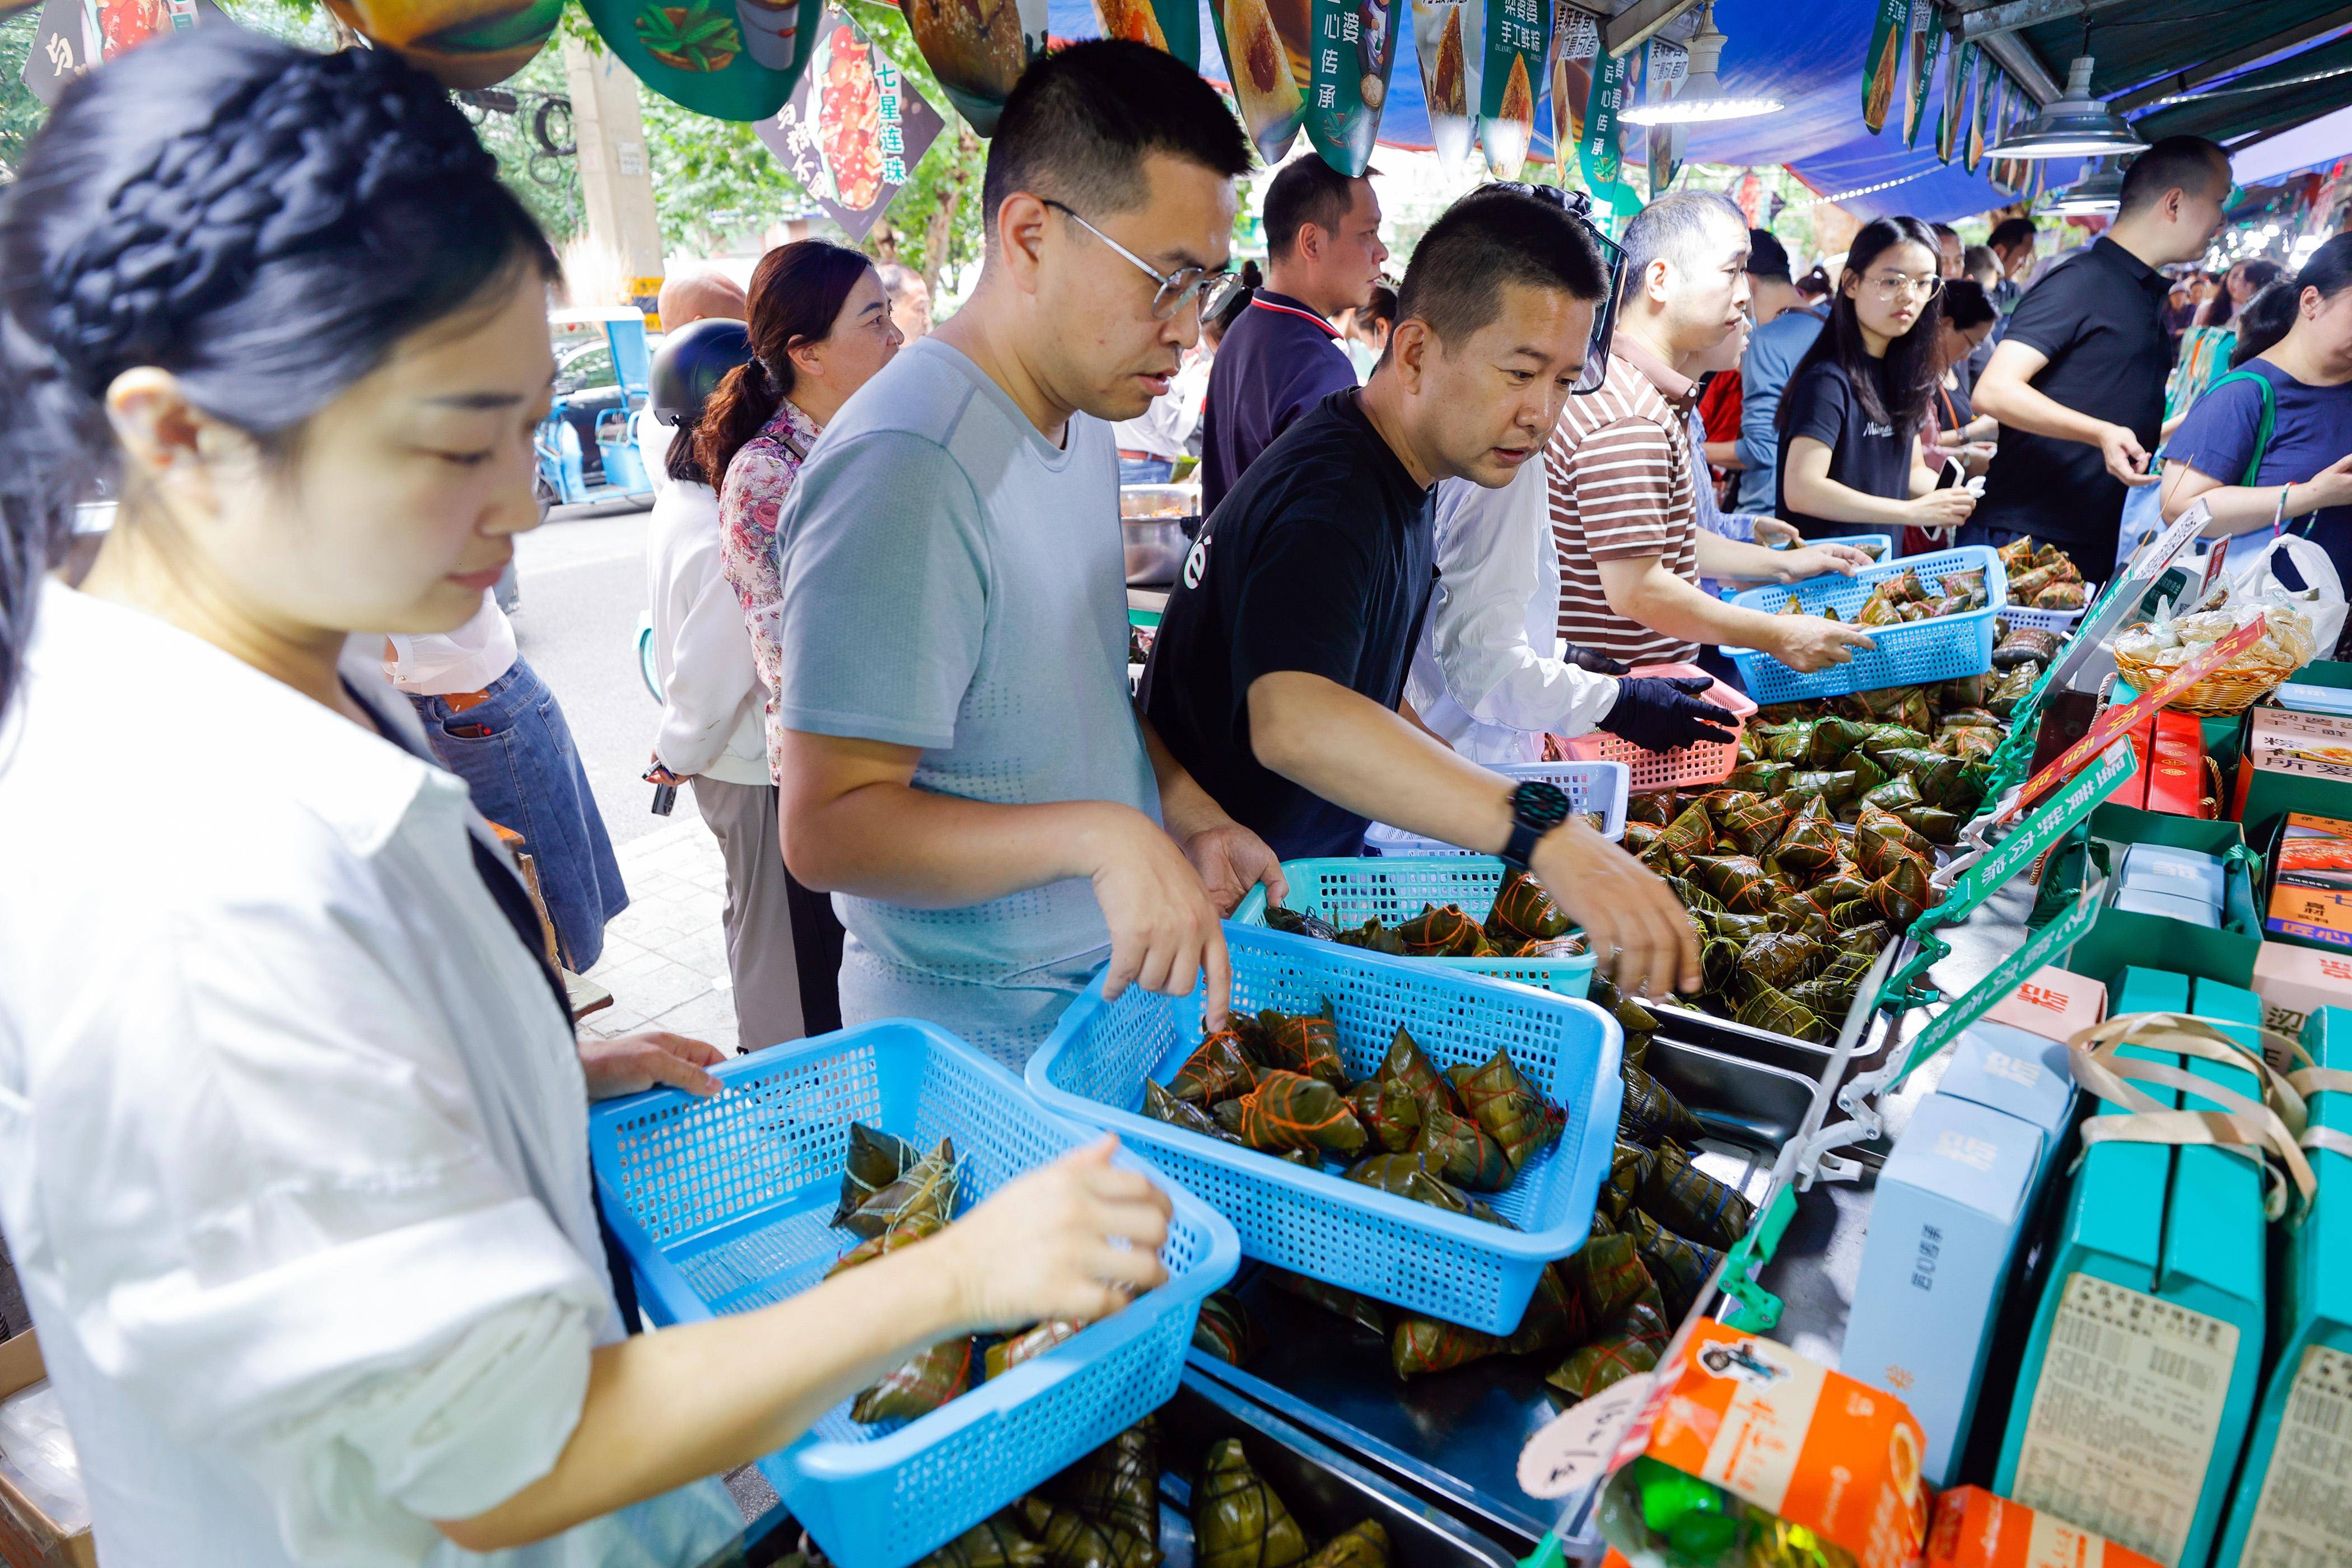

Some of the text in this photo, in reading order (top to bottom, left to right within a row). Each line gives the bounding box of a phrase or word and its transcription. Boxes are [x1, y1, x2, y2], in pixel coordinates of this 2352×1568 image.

[1318, 0, 1340, 109] 心传承
[1501, 20, 1540, 52] 手工鲜粽
[875, 63, 908, 186] 七星连珠
[1591, 64, 1613, 156] 匠心传承
[1981, 755, 2126, 887] 蛋黄鲜肉粽
